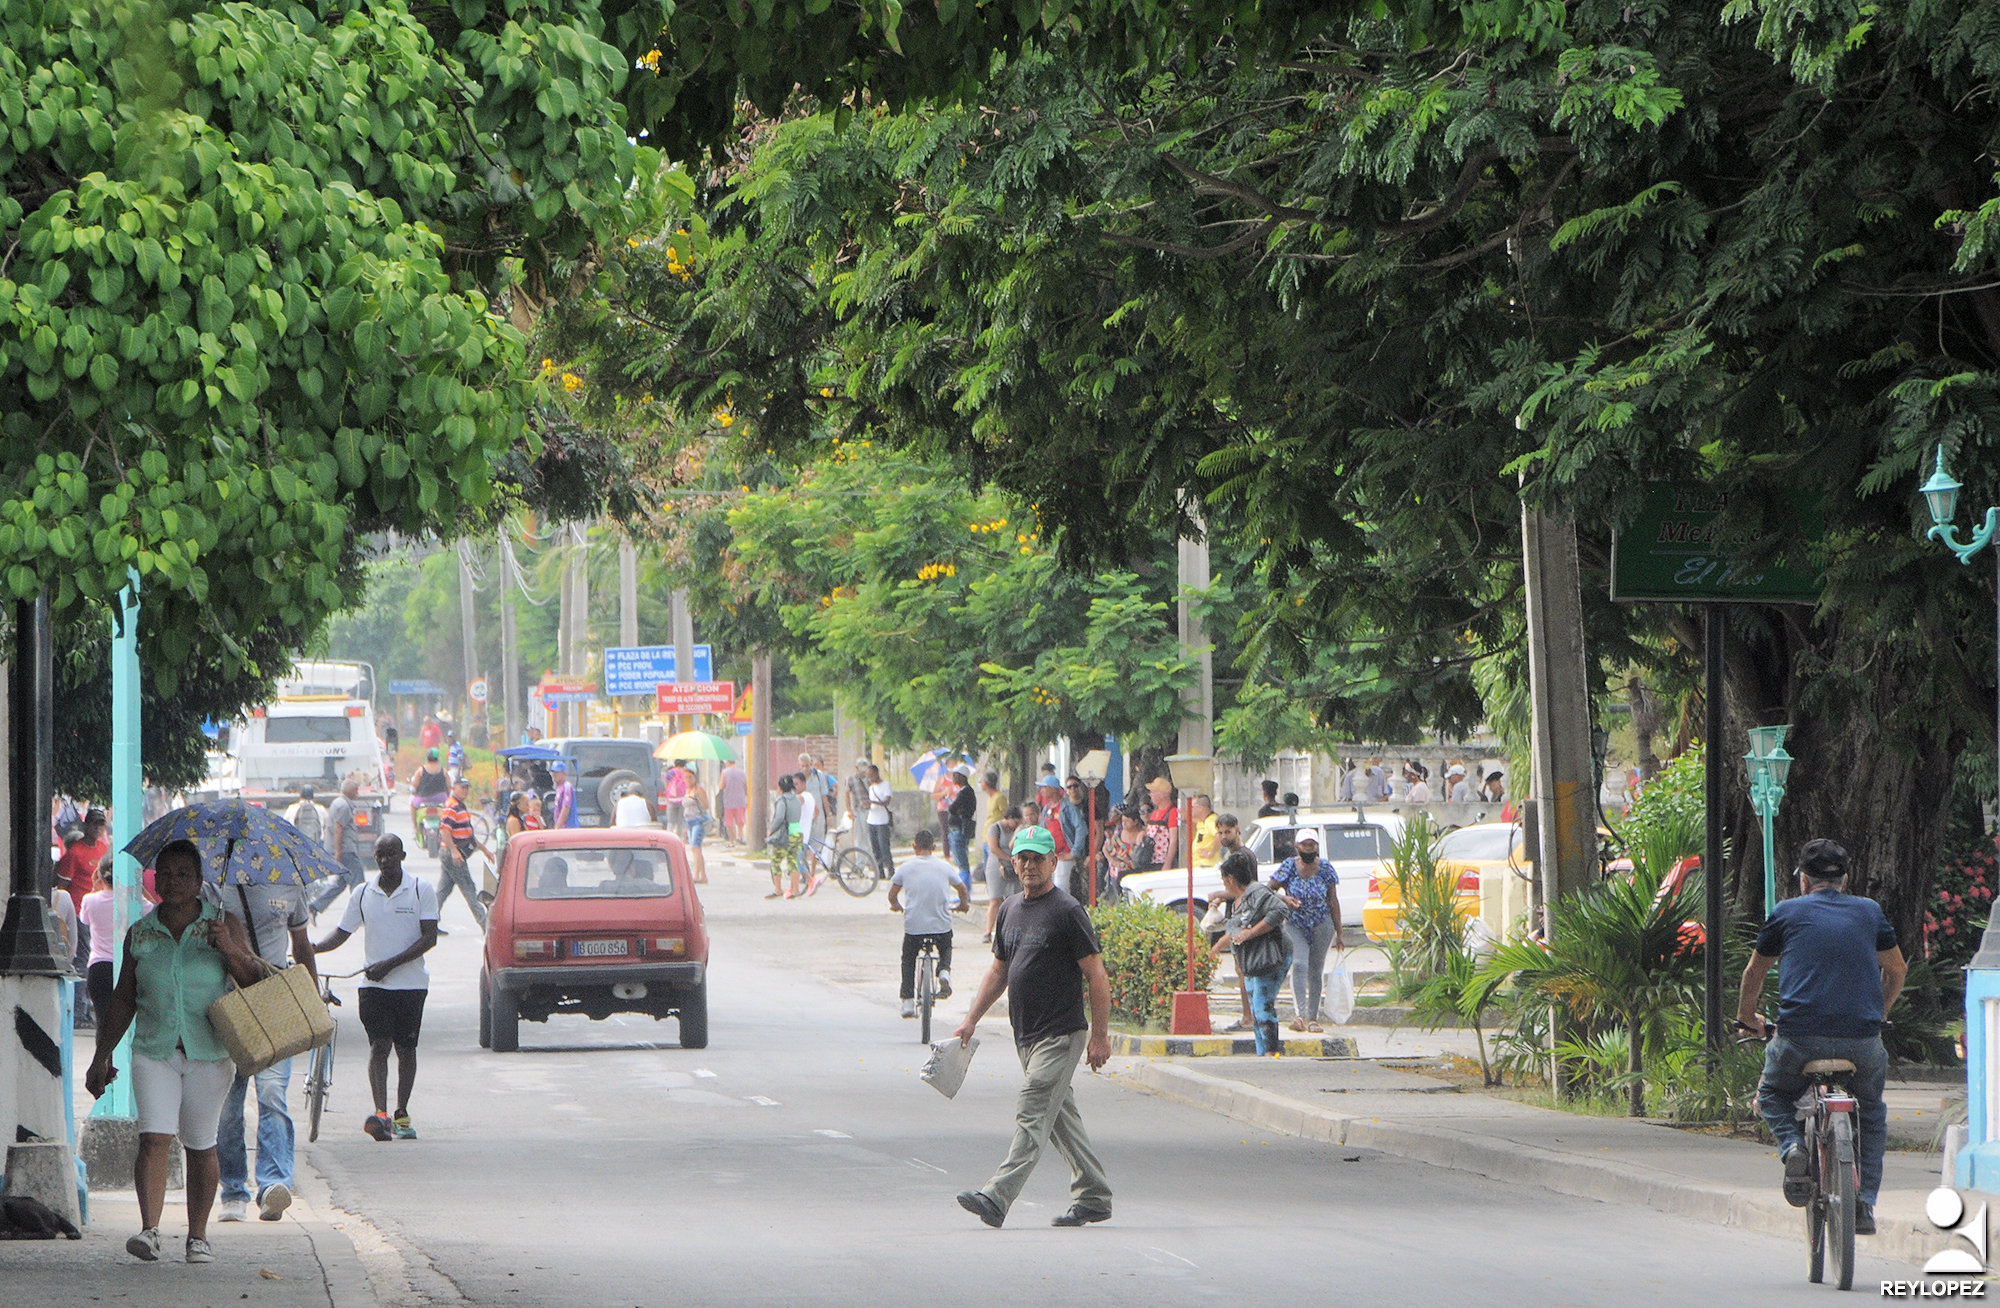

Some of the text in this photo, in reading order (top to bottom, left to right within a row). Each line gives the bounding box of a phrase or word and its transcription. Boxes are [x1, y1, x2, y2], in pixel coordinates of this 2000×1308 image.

[1673, 557, 1717, 585] El
[617, 651, 640, 660] PLAZA
[652, 650, 661, 659] LA
[662, 649, 707, 659] REVION
[617, 662, 632, 671] PCC
[618, 670, 676, 680] PODER POPULAR
[619, 681, 632, 690] PCC
[1025, 827, 1037, 839] T
